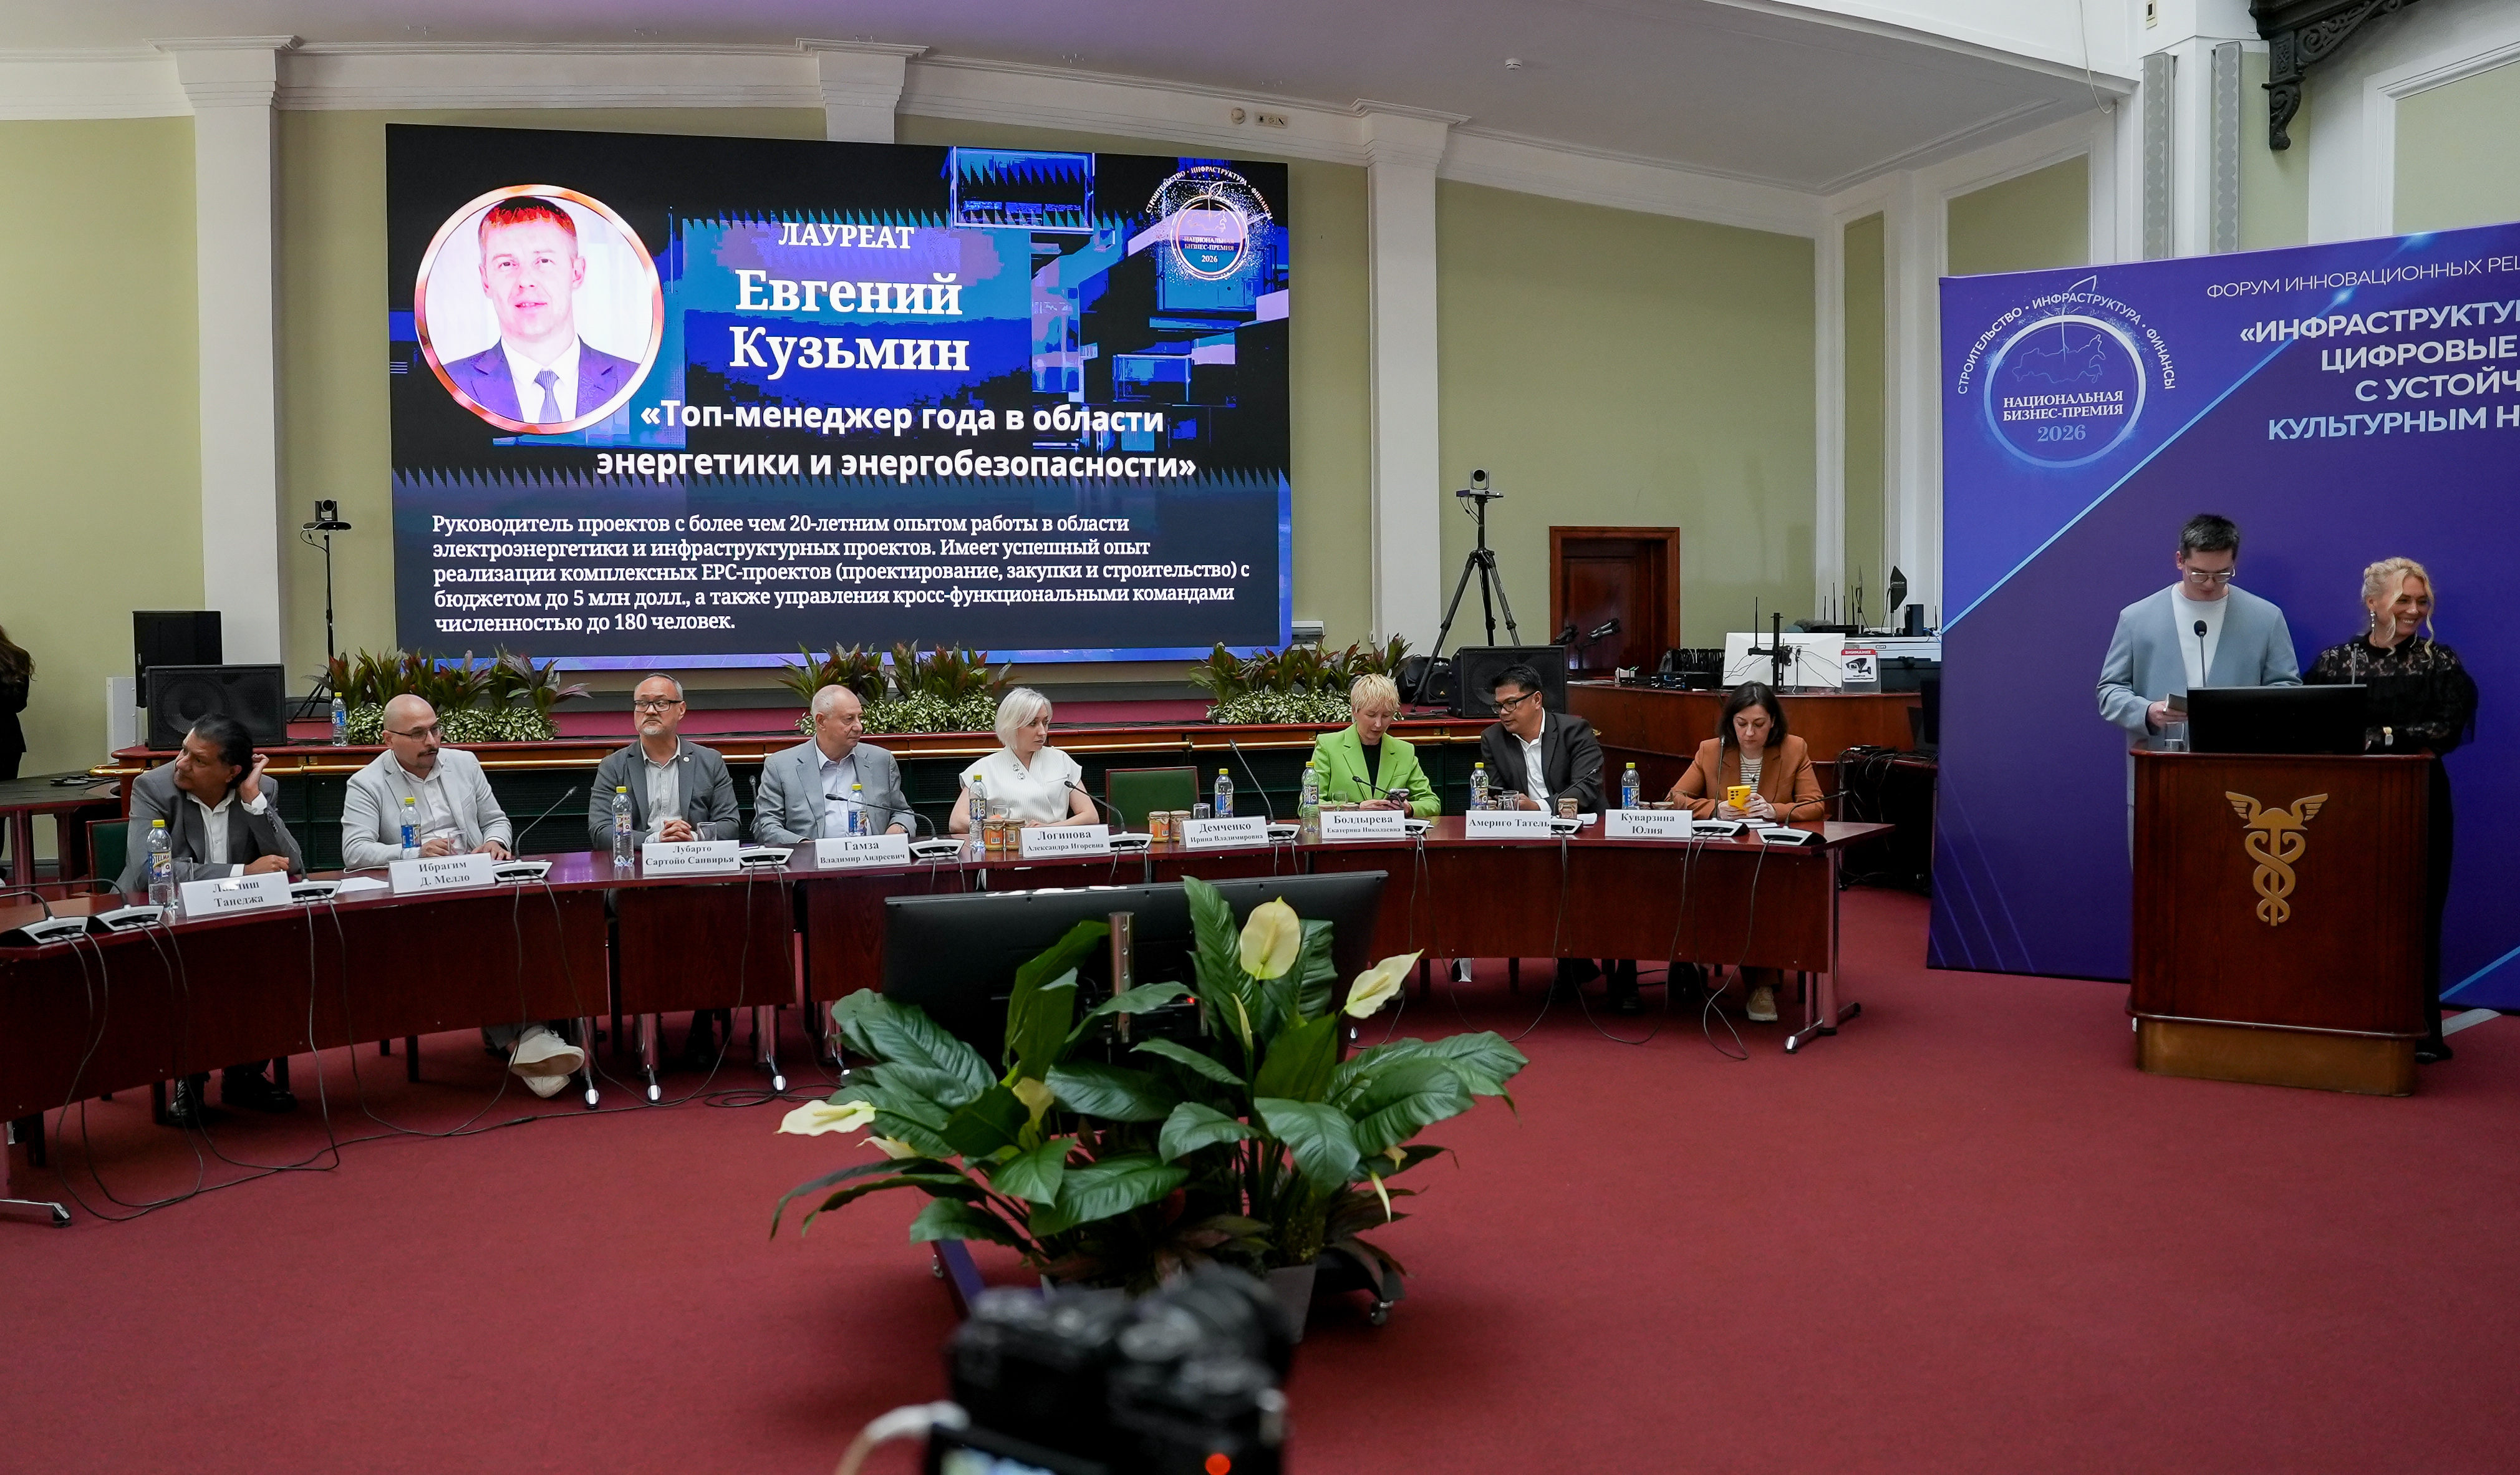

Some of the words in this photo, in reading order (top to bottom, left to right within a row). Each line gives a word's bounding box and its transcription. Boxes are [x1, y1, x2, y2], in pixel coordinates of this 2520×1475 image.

[778, 222, 914, 249] ЛАУРЕАТ
[2207, 278, 2280, 298] ФОРУМ
[2285, 259, 2482, 292] ИННОВАЦИОННЫХ
[735, 269, 963, 315] Евгений
[1958, 307, 2022, 395] СТРОИТЕЛЬСТВО
[2032, 292, 2141, 326] ИНФРАСТРУКТУРА
[2146, 328, 2176, 389] ФИНАНСЫ
[729, 326, 970, 380] Кузьмин
[2321, 334, 2518, 374] ЦИФРОВЫЕ
[2355, 380, 2378, 402] С
[2385, 365, 2520, 400] УСТОЙЧ
[2003, 390, 2123, 409] НАЦИОНАЛЬНАЯ
[640, 399, 912, 437] «Топ-менеджер
[922, 409, 995, 436] года
[1006, 410, 1025, 430] в
[1033, 404, 1164, 432] области
[2003, 404, 2123, 422] БИЗНЕС-ПРЕМИЯ
[2269, 407, 2486, 440] КУЛЬТУРНЫМ
[2037, 425, 2087, 442] 2026
[597, 453, 799, 482] энергетики
[811, 455, 831, 475] и
[842, 450, 1196, 483] энергобезопасности»
[432, 515, 574, 537] Руководитель
[577, 518, 670, 537] проектов
[675, 518, 685, 532] с
[689, 514, 743, 531] более
[747, 518, 786, 531] чем
[789, 515, 890, 531] 20-летним
[893, 518, 968, 531] опытом
[970, 514, 1038, 536] работы
[1041, 518, 1053, 531] в
[1057, 514, 1130, 531] области
[433, 543, 629, 562] электроэнергетики
[632, 543, 647, 556] и
[650, 538, 841, 561] инфраструктурных
[843, 542, 936, 560] проектов.
[940, 539, 1000, 556] Имеет
[1002, 538, 1101, 559] успешный
[1103, 542, 1151, 555] опыт
[433, 568, 557, 588] реализации
[559, 567, 698, 581] комплексных
[836, 562, 1003, 584] (проектирование,
[1006, 565, 1083, 584] закупки
[1085, 565, 1099, 578] и
[1103, 561, 1237, 583] строительство)
[1240, 564, 1250, 577] с
[434, 589, 542, 611] бюджетом
[544, 593, 569, 611] до
[573, 589, 584, 606] 5
[587, 592, 631, 606] млн
[634, 592, 692, 610] долл.,
[695, 592, 706, 605] а
[710, 591, 771, 605] также
[773, 590, 891, 609] управления
[892, 585, 1130, 608] кросс-функциональными
[1132, 588, 1235, 604] командами
[434, 617, 583, 632] численностью
[586, 617, 610, 634] до
[614, 613, 647, 630] 180
[650, 616, 735, 630] человек.
[1334, 815, 1393, 825] Болдырева
[1469, 819, 1512, 828] Америго
[1515, 819, 1550, 827] Татель
[1621, 813, 1674, 823] Куварзина
[1037, 831, 1092, 841] Логинова
[1199, 823, 1252, 833] Демченко
[1632, 826, 1663, 834] Юлия
[673, 845, 712, 854] Лубарто
[844, 841, 879, 851] Гамза
[418, 862, 467, 873] Ибрагим
[645, 858, 685, 867] Сартойо
[820, 856, 861, 864] Владимир
[863, 854, 905, 862] Андреевич
[213, 881, 259, 893] Ллиш
[420, 877, 432, 887] Д.
[435, 875, 470, 884] Мелло
[214, 896, 264, 907] Танеджа
